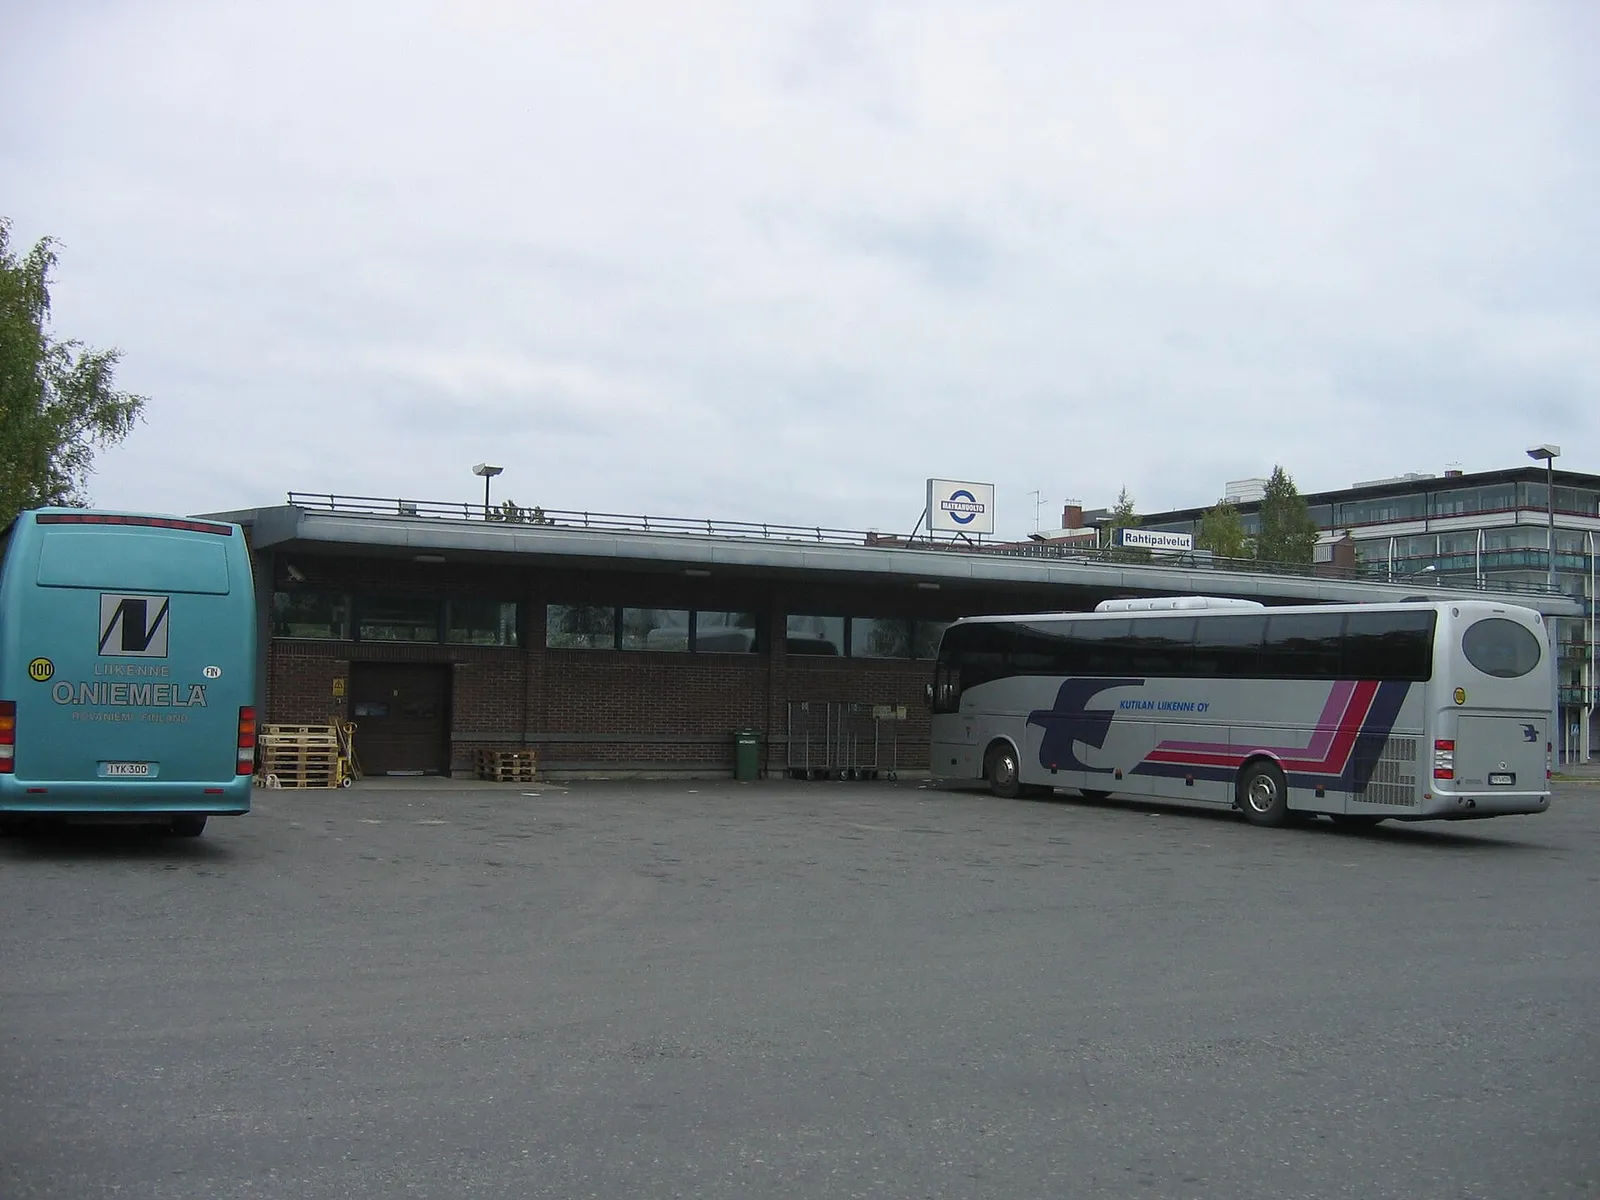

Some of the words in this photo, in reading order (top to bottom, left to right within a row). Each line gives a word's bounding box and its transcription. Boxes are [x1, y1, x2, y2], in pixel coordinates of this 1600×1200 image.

[942, 502, 984, 512] MATKAHUOLTO
[1125, 533, 1190, 547] Rahtipalvelut
[31, 663, 52, 677] 100
[94, 663, 170, 677] LIIKENNE
[206, 667, 218, 677] FIN
[52, 681, 208, 707] O.NIEMELÄ
[1120, 700, 1154, 710] KUTILAN
[1157, 701, 1195, 712] LIIKENNE
[1197, 702, 1210, 712] OY
[72, 711, 133, 722] ROVANIEMI
[141, 712, 188, 723] FINLAND
[110, 764, 147, 774] IYK-300
